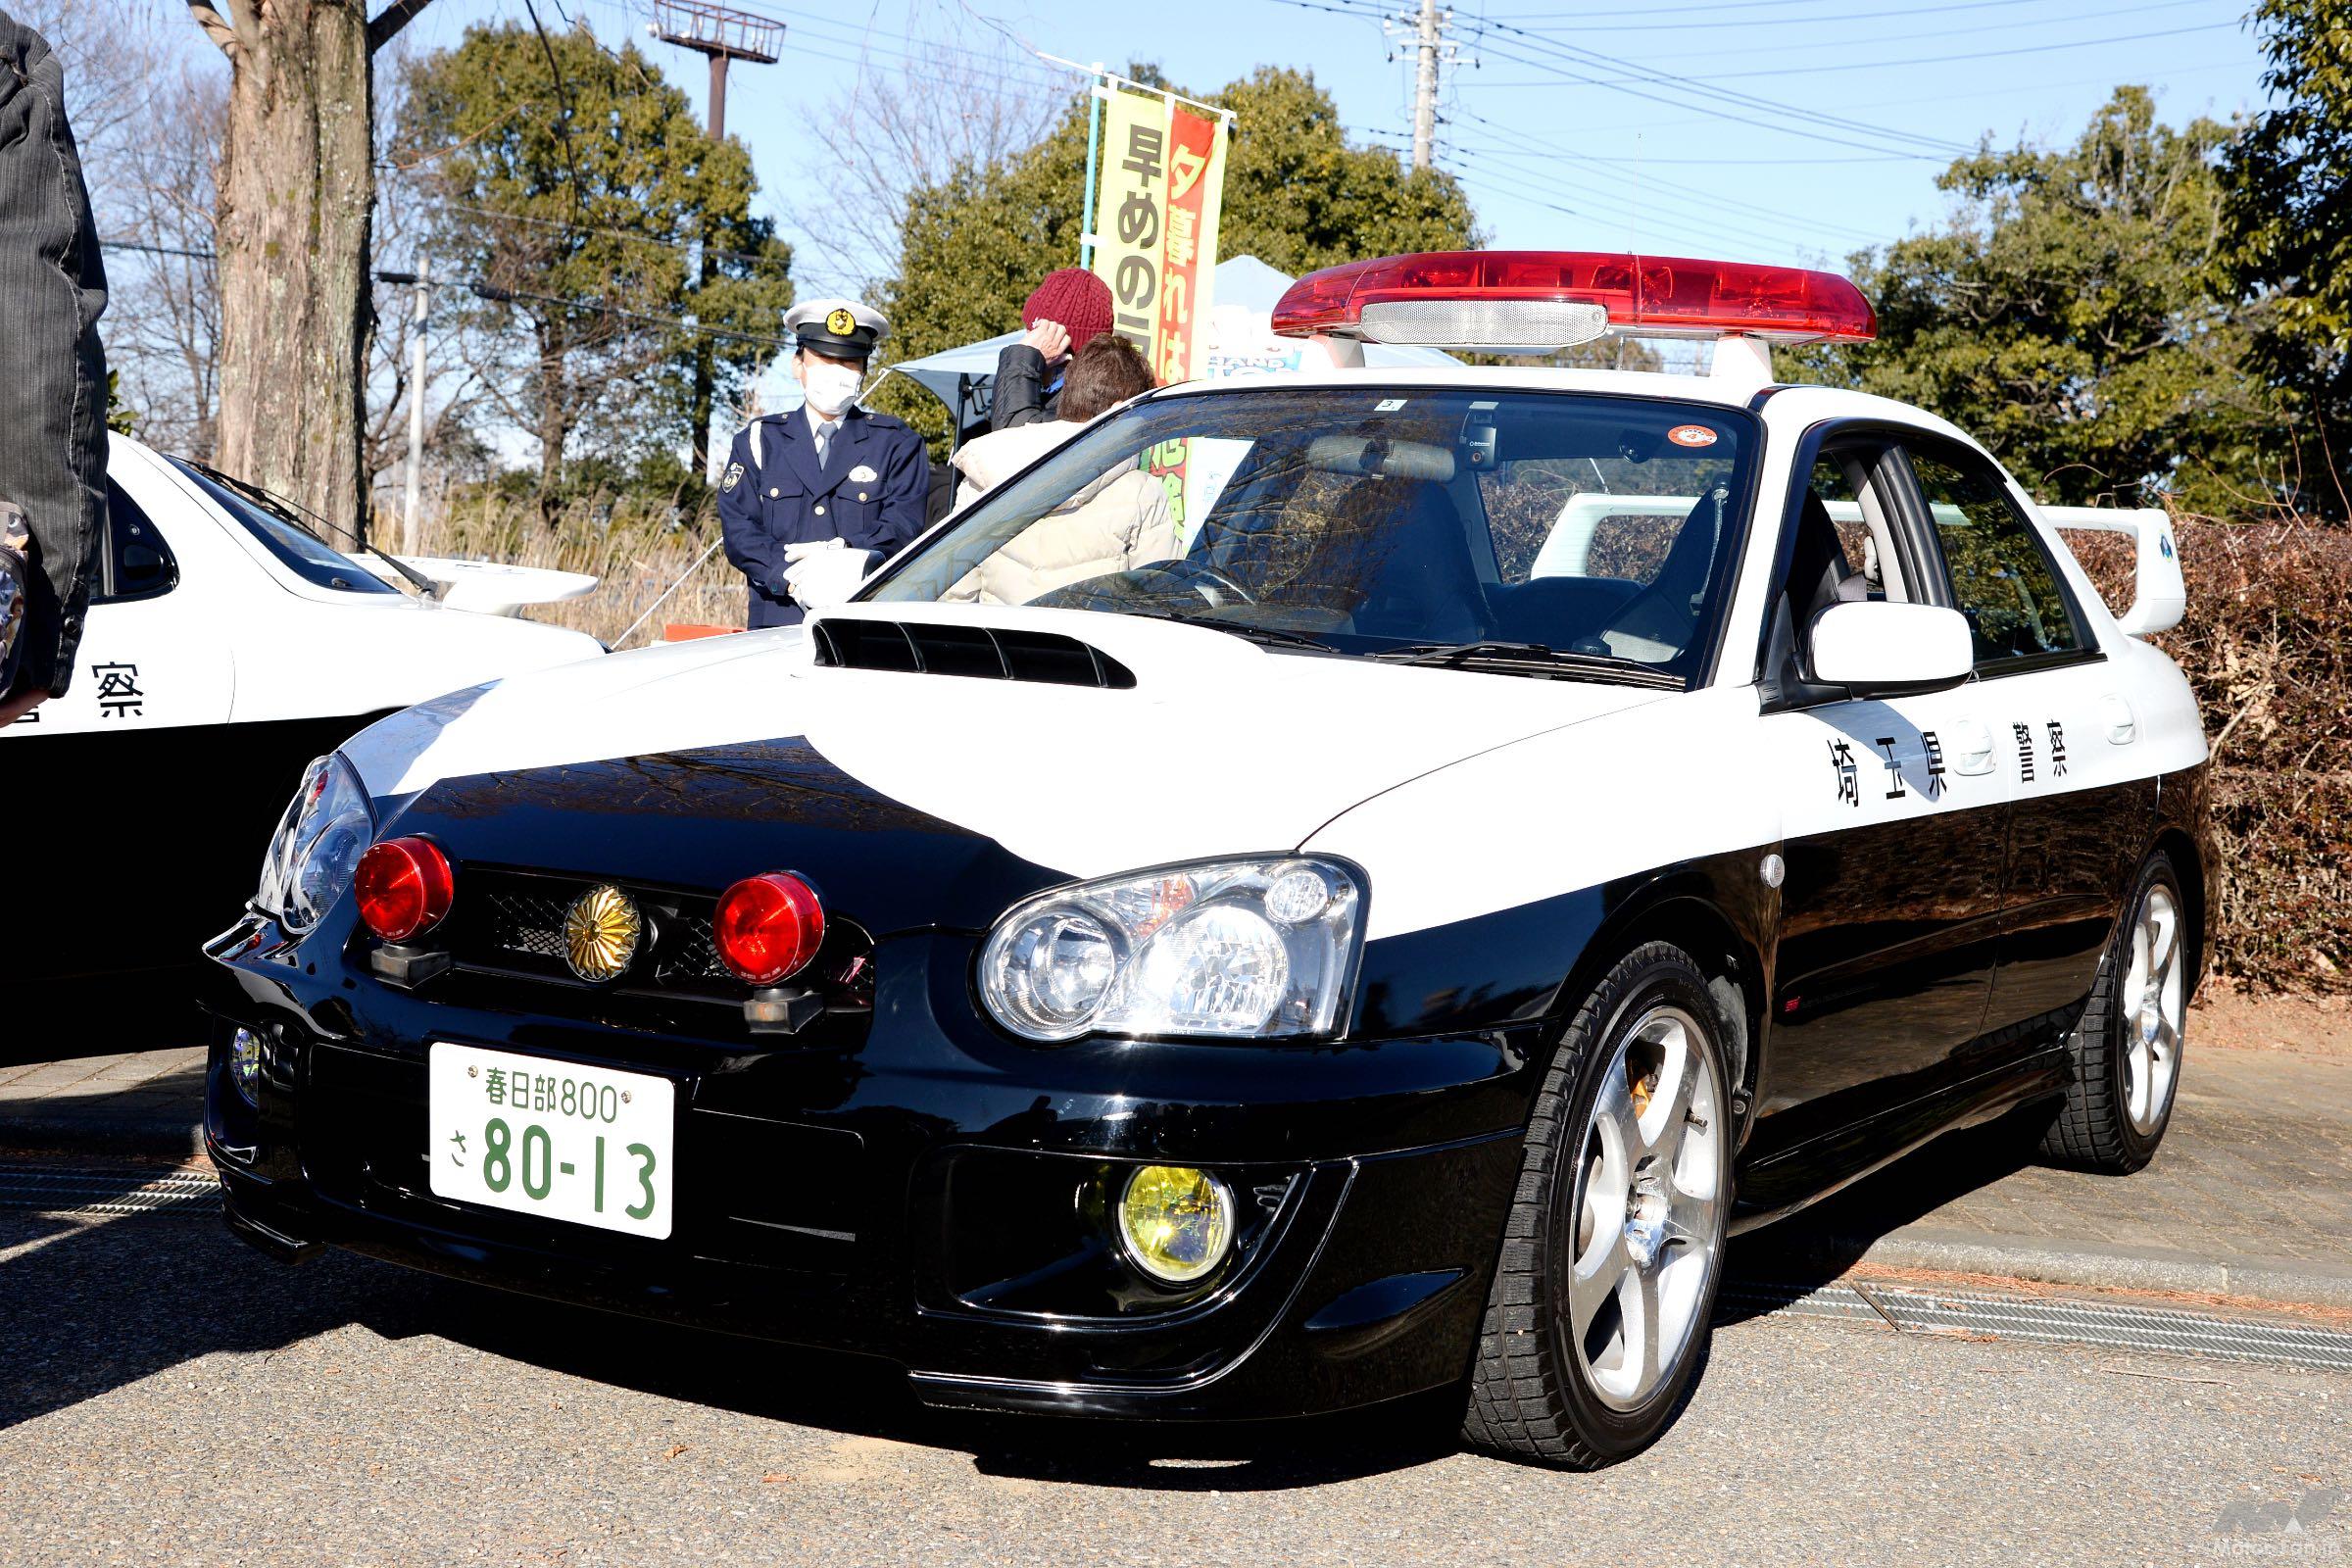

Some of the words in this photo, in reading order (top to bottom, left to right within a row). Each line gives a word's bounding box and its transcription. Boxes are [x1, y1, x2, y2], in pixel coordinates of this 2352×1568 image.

[1159, 143, 1206, 386] 夕暮れは
[1827, 730, 1948, 808] 埼玉県
[2012, 716, 2069, 784] 警察
[485, 1066, 618, 1124] 春日部800
[448, 1129, 466, 1168] さ
[482, 1116, 658, 1221] 80-13
